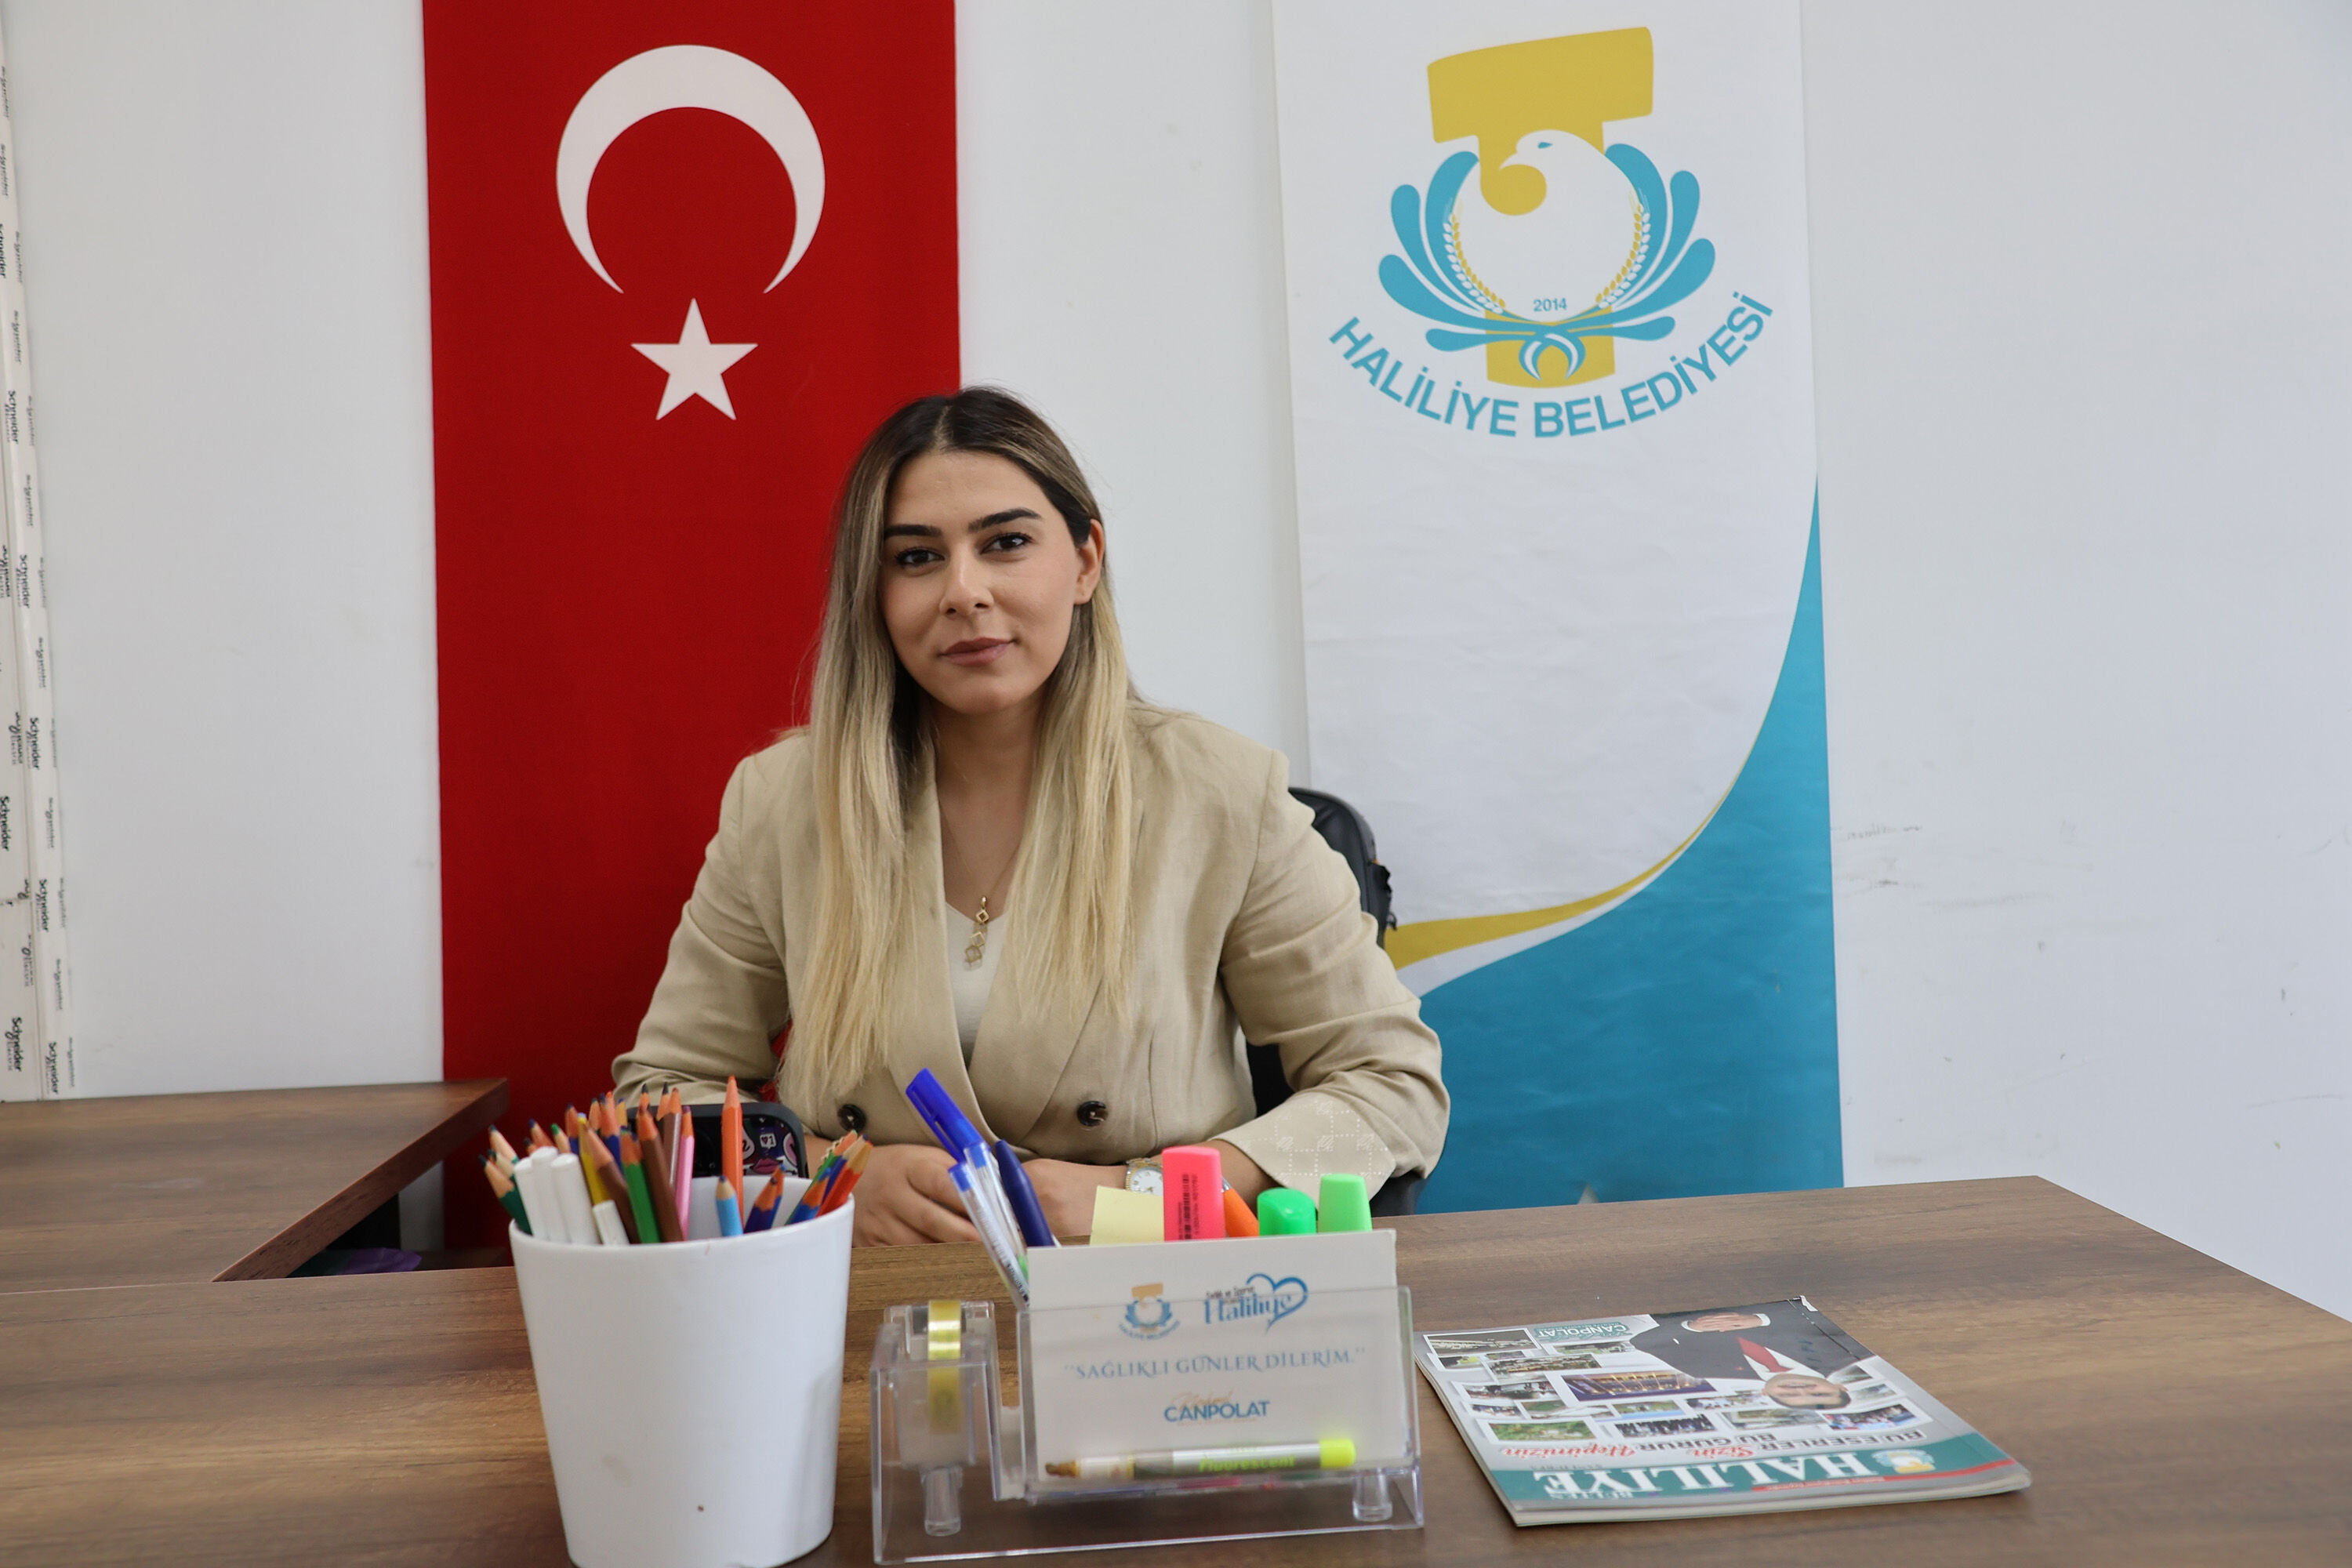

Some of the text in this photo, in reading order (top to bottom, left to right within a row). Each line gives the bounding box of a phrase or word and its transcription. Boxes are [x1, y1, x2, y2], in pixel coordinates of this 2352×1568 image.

[1533, 297, 1568, 312] 2014
[1328, 291, 1773, 438] HALİLİYE BELEDİYESİ
[5, 1016, 23, 1073] Schneider
[1538, 1323, 1627, 1338] CANPOLAT
[1163, 1400, 1271, 1422] CANPOLAT
[1504, 1433, 1776, 1459] BU GURUR Hepimizin
[1693, 1429, 1924, 1459] BU ESERLER Sizin
